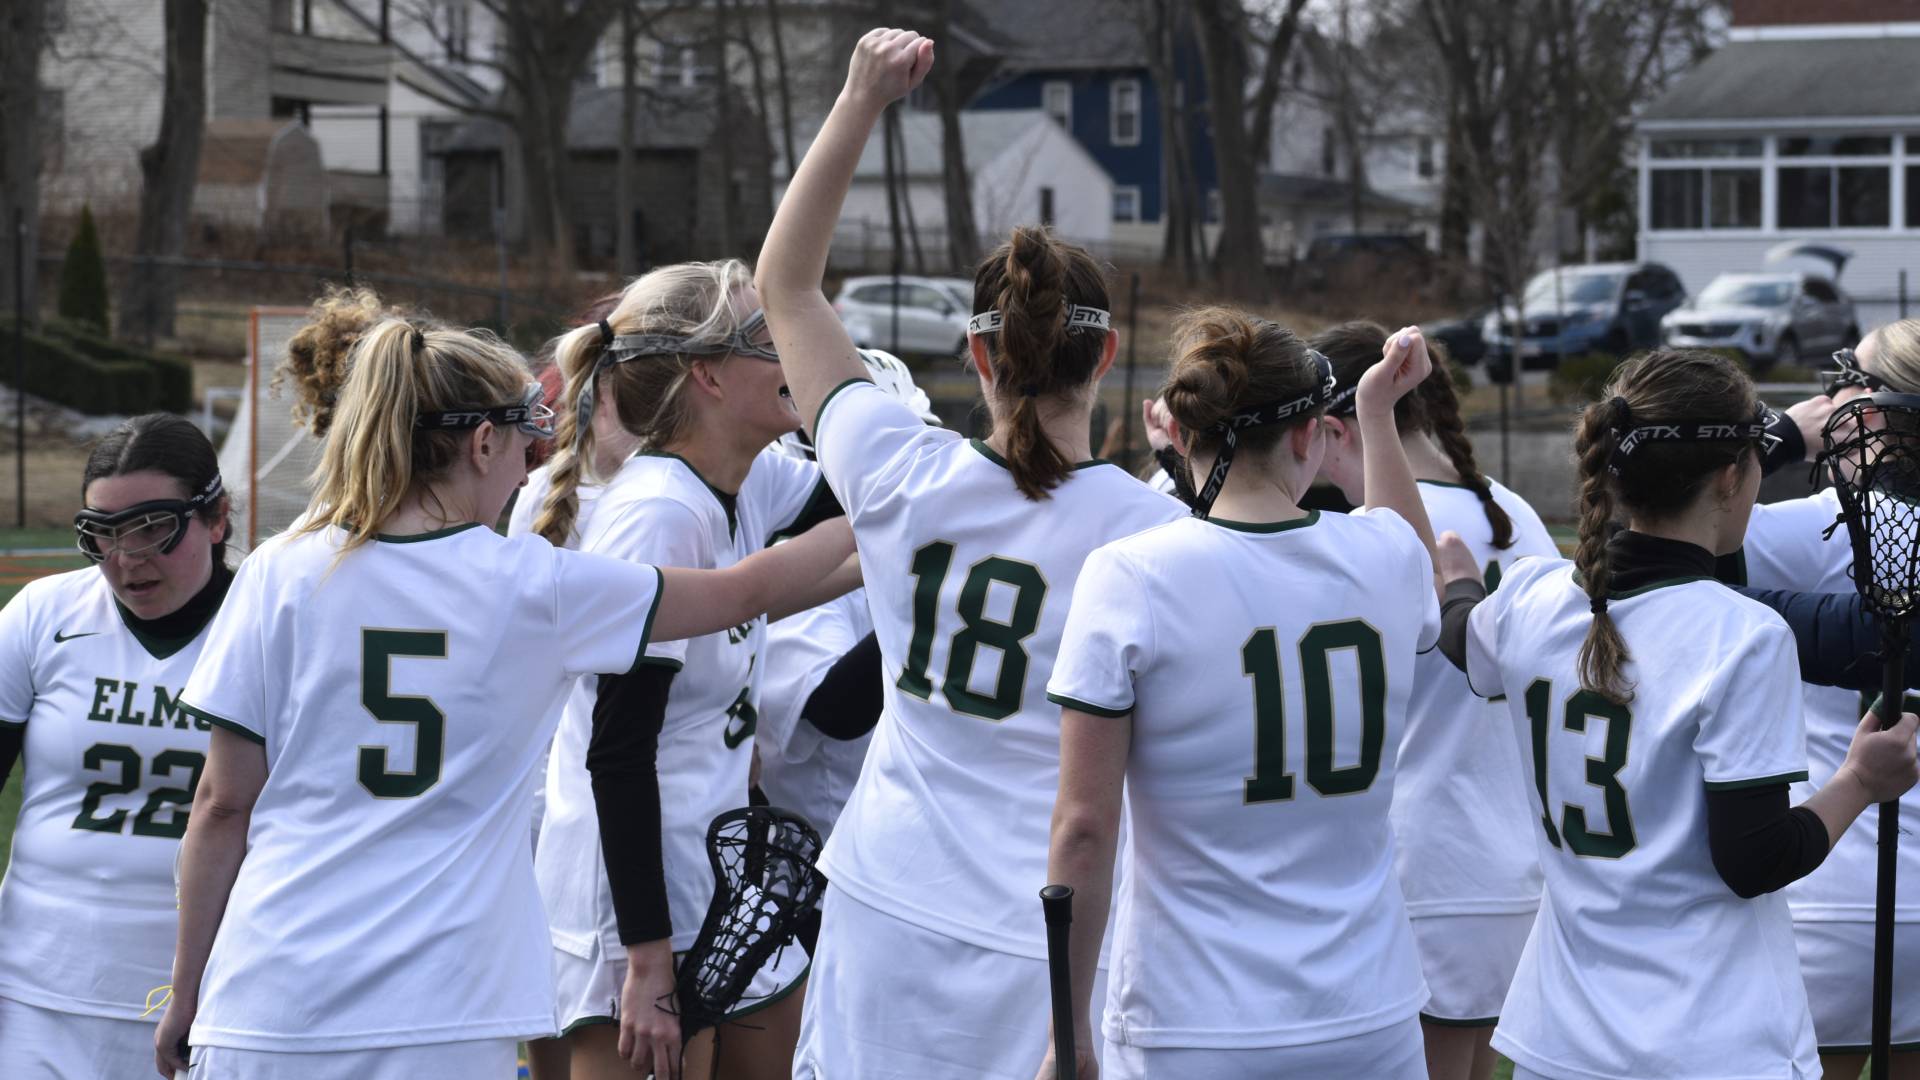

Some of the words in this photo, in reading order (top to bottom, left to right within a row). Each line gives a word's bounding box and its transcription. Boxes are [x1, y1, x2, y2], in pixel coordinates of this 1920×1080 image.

[1073, 307, 1102, 324] STX
[441, 410, 490, 427] STX
[504, 407, 530, 422] ST
[1231, 411, 1263, 430] TX
[1277, 392, 1316, 420] STX
[1697, 424, 1738, 438] STX
[1618, 429, 1643, 456] ST
[1203, 455, 1231, 505] STX
[896, 538, 1049, 723] 18
[356, 626, 449, 800] 5
[1239, 616, 1388, 806] 10
[70, 741, 208, 839] 22
[1523, 676, 1639, 861] 13
